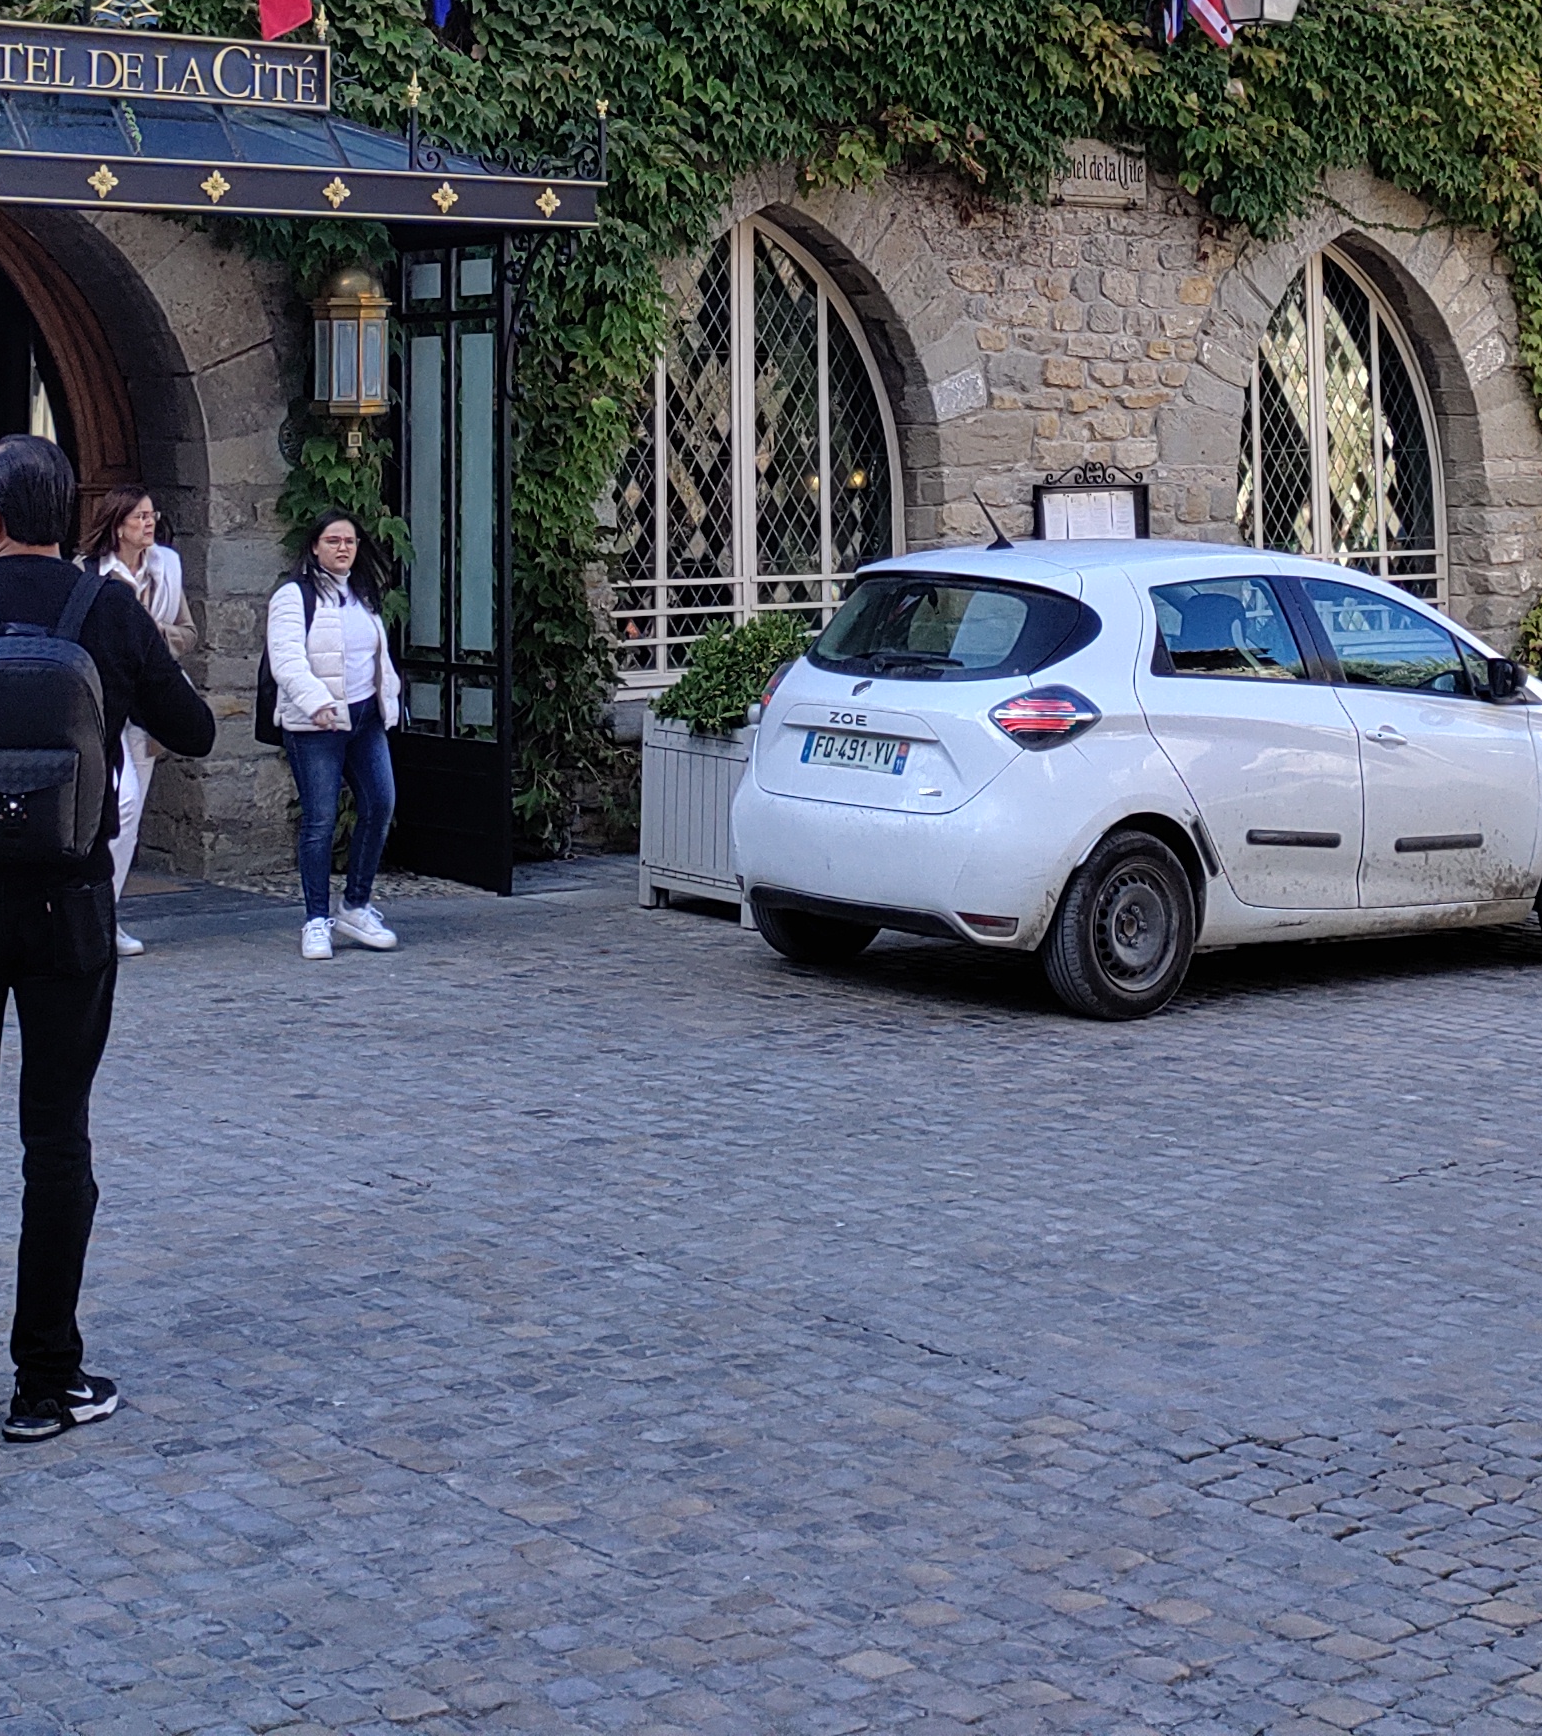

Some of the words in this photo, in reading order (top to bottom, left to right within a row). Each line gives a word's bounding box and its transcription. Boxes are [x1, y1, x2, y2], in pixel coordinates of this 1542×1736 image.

[87, 49, 144, 92] DE
[154, 54, 209, 96] LA
[829, 711, 867, 726] ZOE
[896, 759, 904, 771] 11
